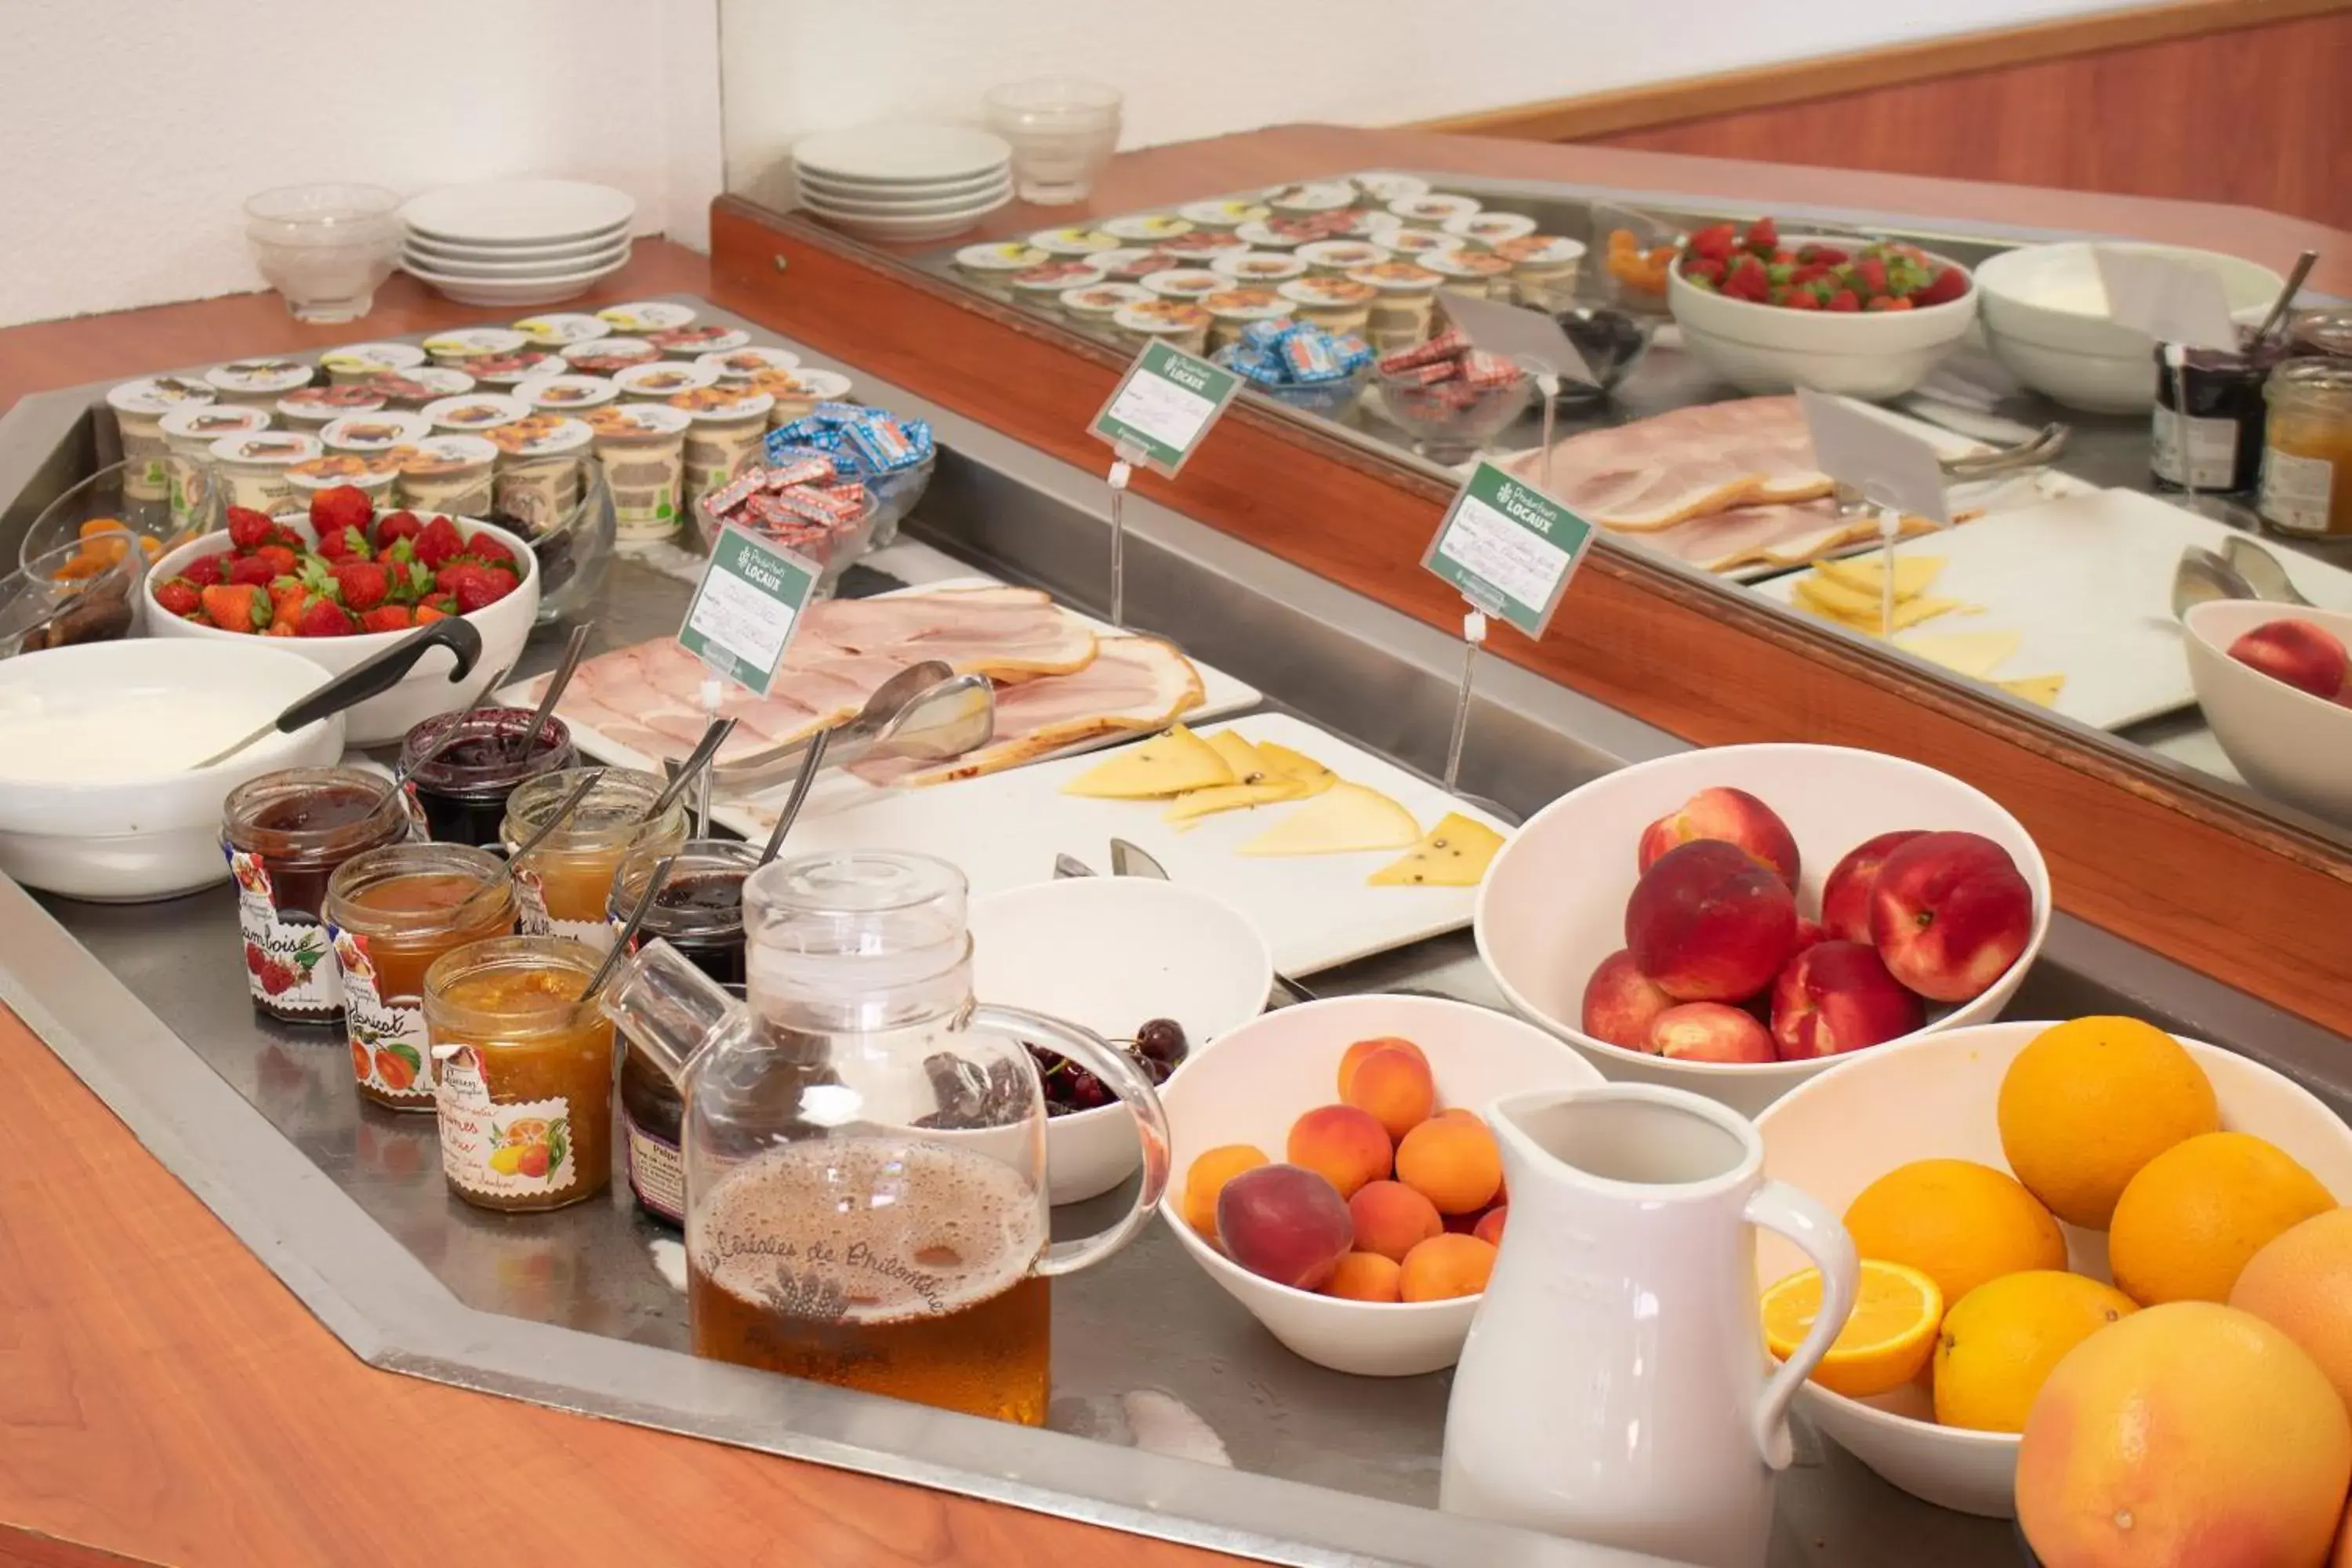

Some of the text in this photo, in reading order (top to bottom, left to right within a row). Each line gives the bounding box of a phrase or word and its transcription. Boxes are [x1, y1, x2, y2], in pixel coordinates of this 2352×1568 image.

[1506, 499, 1553, 535] LOCAUX
[745, 563, 782, 591] LOCAUX
[806, 1240, 834, 1261] de
